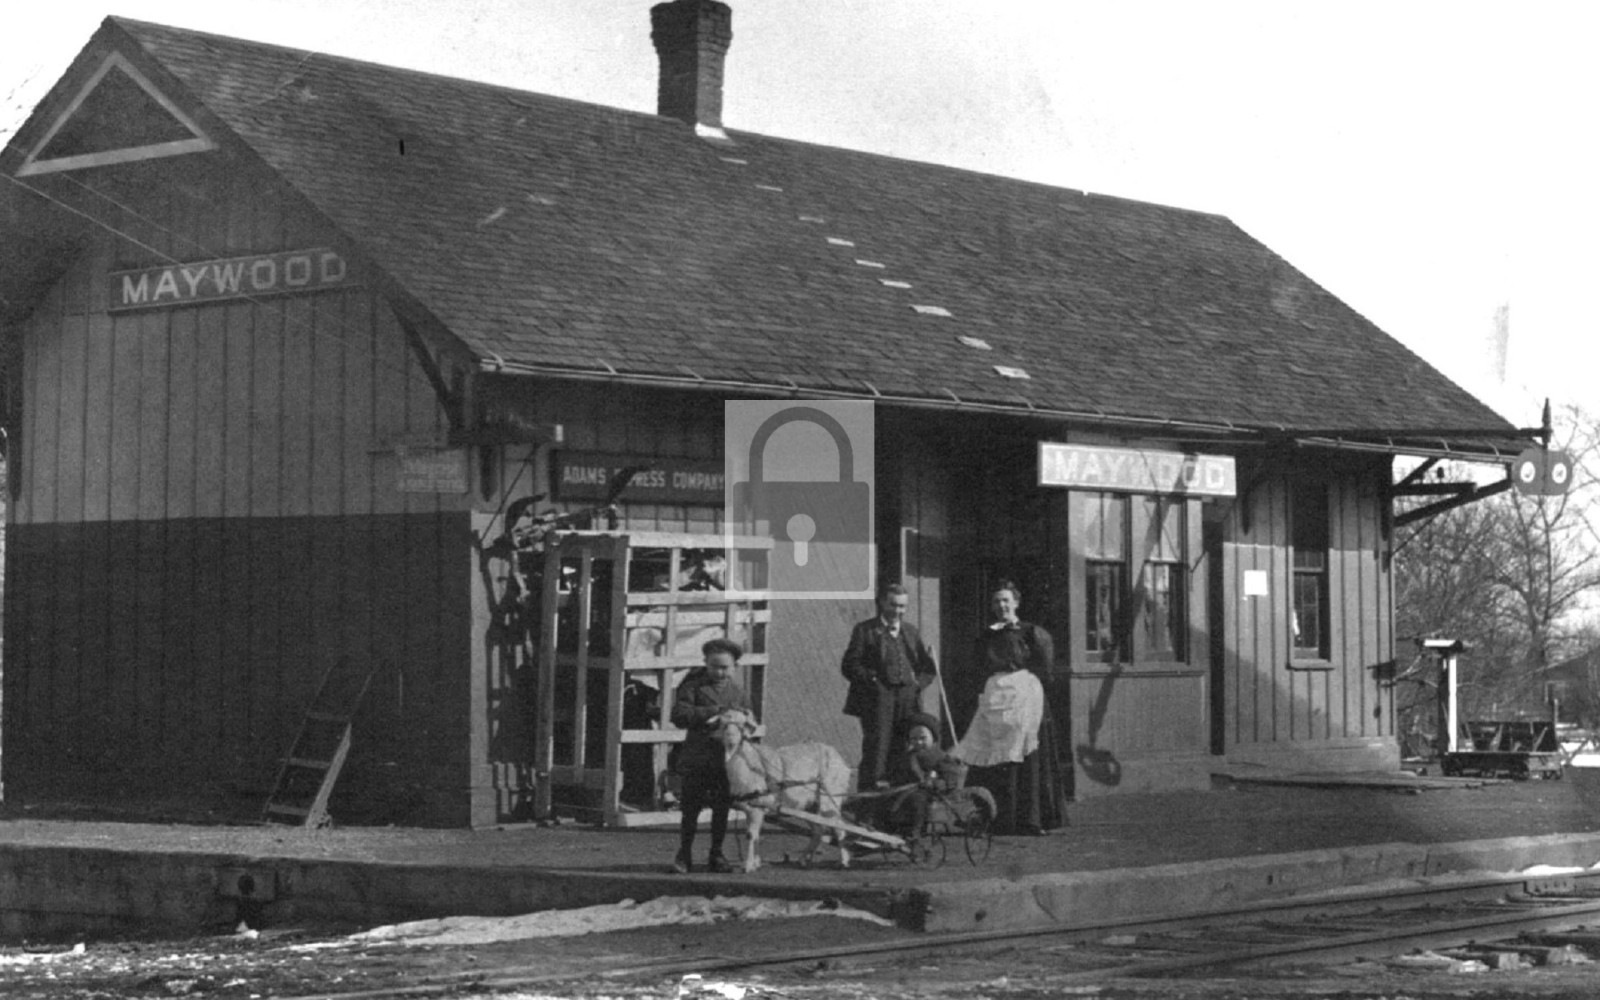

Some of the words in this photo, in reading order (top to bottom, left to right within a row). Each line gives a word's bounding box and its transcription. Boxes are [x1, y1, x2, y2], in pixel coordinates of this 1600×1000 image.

[121, 252, 346, 304] MAYWOOD
[563, 465, 606, 484] ADAMS
[613, 468, 665, 488] PRESS
[1055, 450, 1225, 489] MAYWOOD
